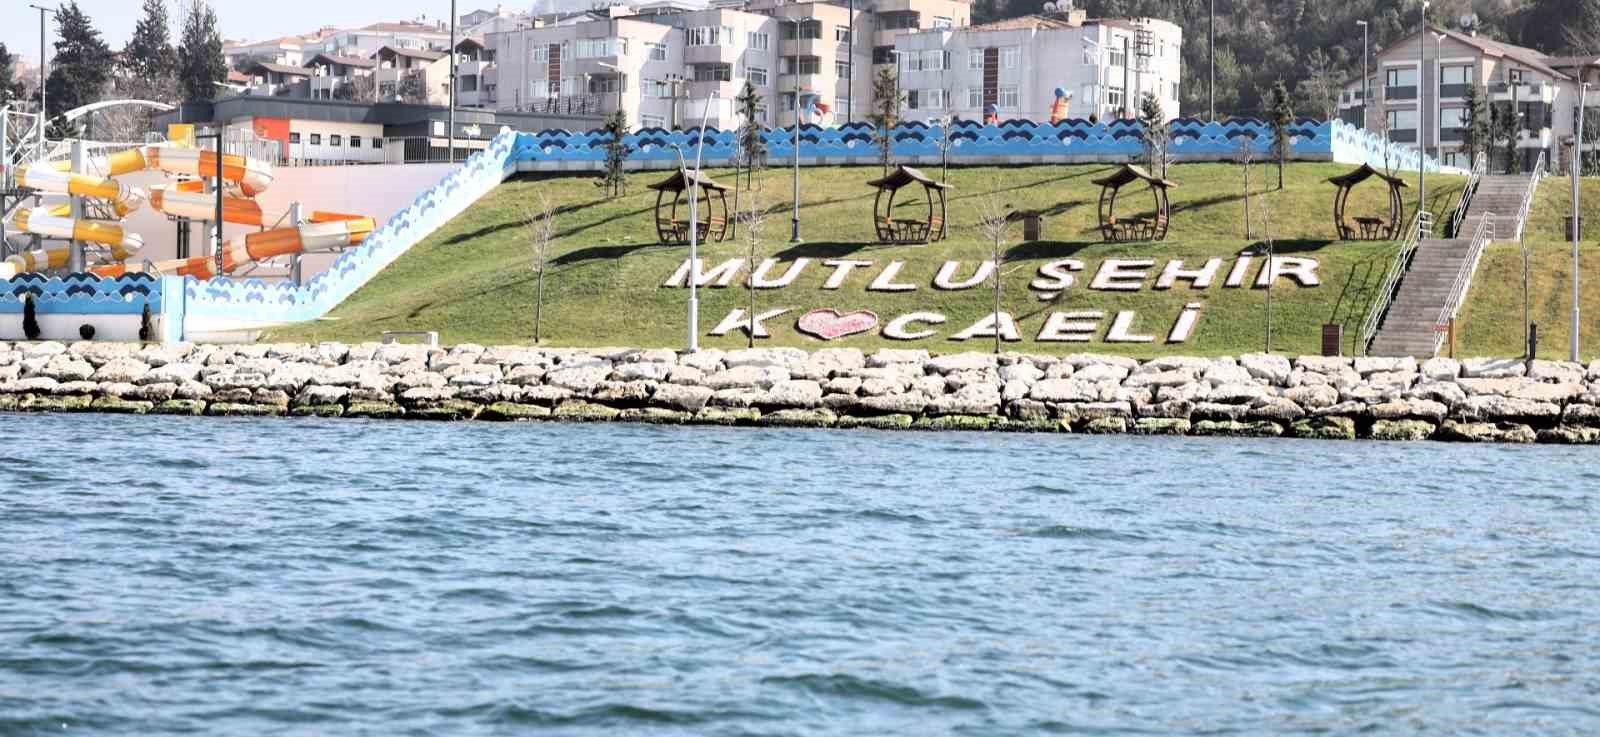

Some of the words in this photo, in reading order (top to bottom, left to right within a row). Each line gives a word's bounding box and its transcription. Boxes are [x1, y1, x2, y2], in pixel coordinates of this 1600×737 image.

[662, 256, 997, 290] MUTLU
[1028, 251, 1320, 300] ŞEHİR
[707, 302, 1200, 344] KCAELİ
